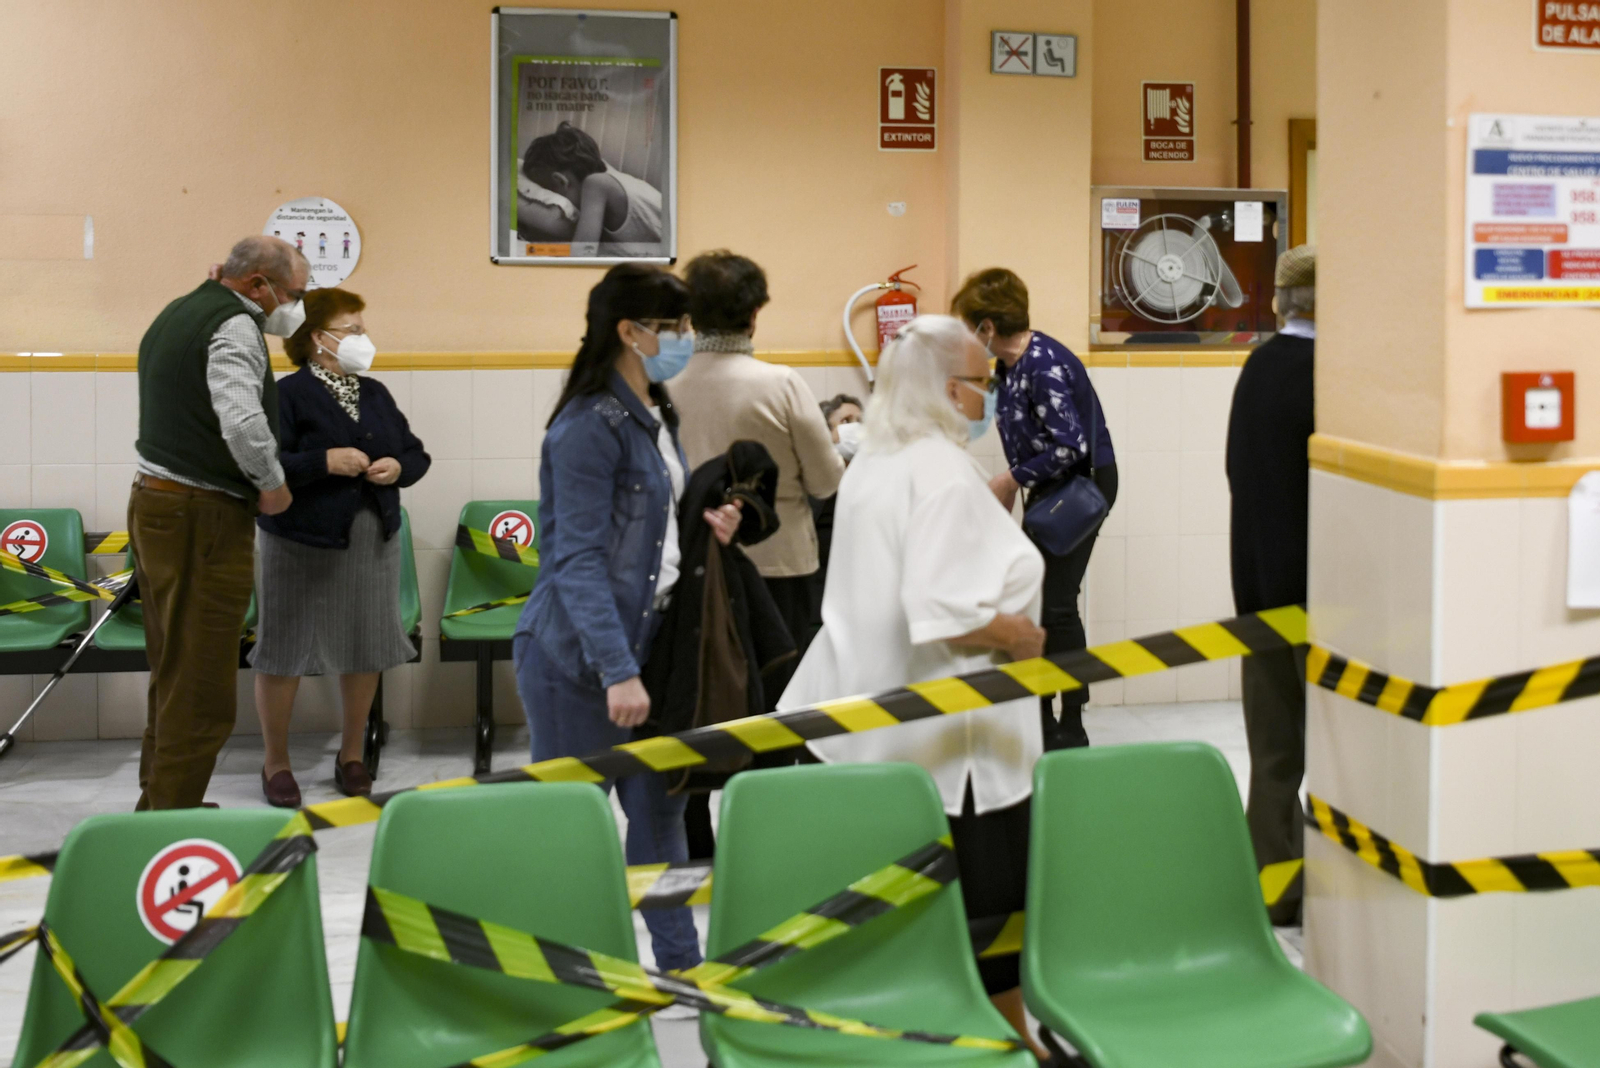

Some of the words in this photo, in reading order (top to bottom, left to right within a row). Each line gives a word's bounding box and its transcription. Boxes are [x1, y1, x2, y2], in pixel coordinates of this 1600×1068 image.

[1542, 24, 1565, 43] DE
[883, 132, 932, 142] EXTINTOR
[1150, 141, 1174, 150] BOCA
[1175, 141, 1187, 150] DE
[1149, 151, 1189, 160] INCENDIO
[290, 207, 326, 215] Mantengan
[310, 263, 338, 271] etros
